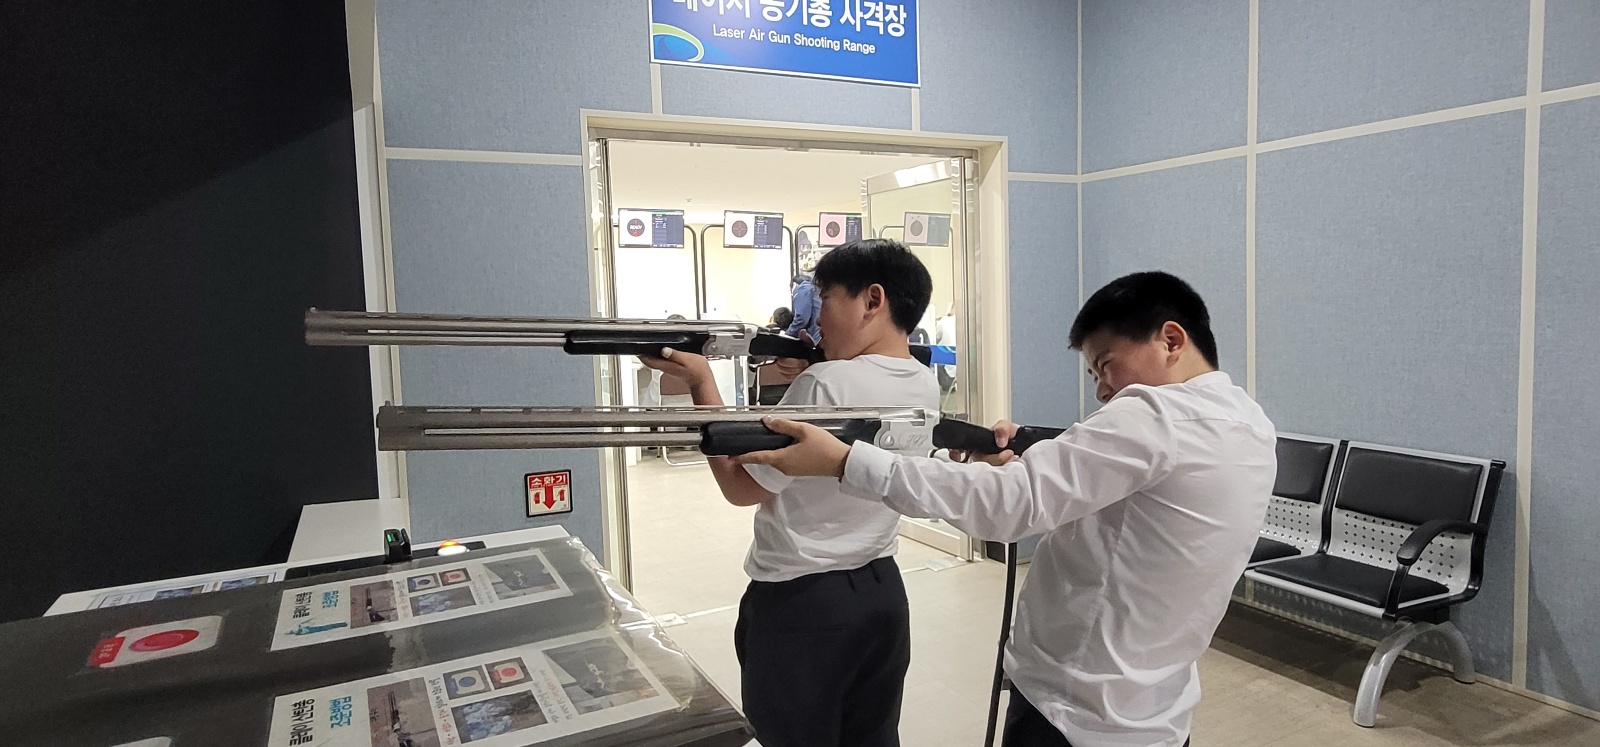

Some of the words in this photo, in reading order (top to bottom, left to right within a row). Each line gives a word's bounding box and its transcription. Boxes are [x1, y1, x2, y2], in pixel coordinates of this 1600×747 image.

[839, 0, 908, 38] 사격장
[712, 23, 745, 39] Laser
[748, 28, 766, 41] Air
[768, 30, 791, 45] Gun
[793, 33, 841, 51] Shooting
[843, 39, 876, 54] Range
[531, 474, 567, 488] 소화기
[291, 698, 315, 722] 산탄총
[329, 696, 352, 729] 조준방법
[289, 720, 314, 746] 클레이
